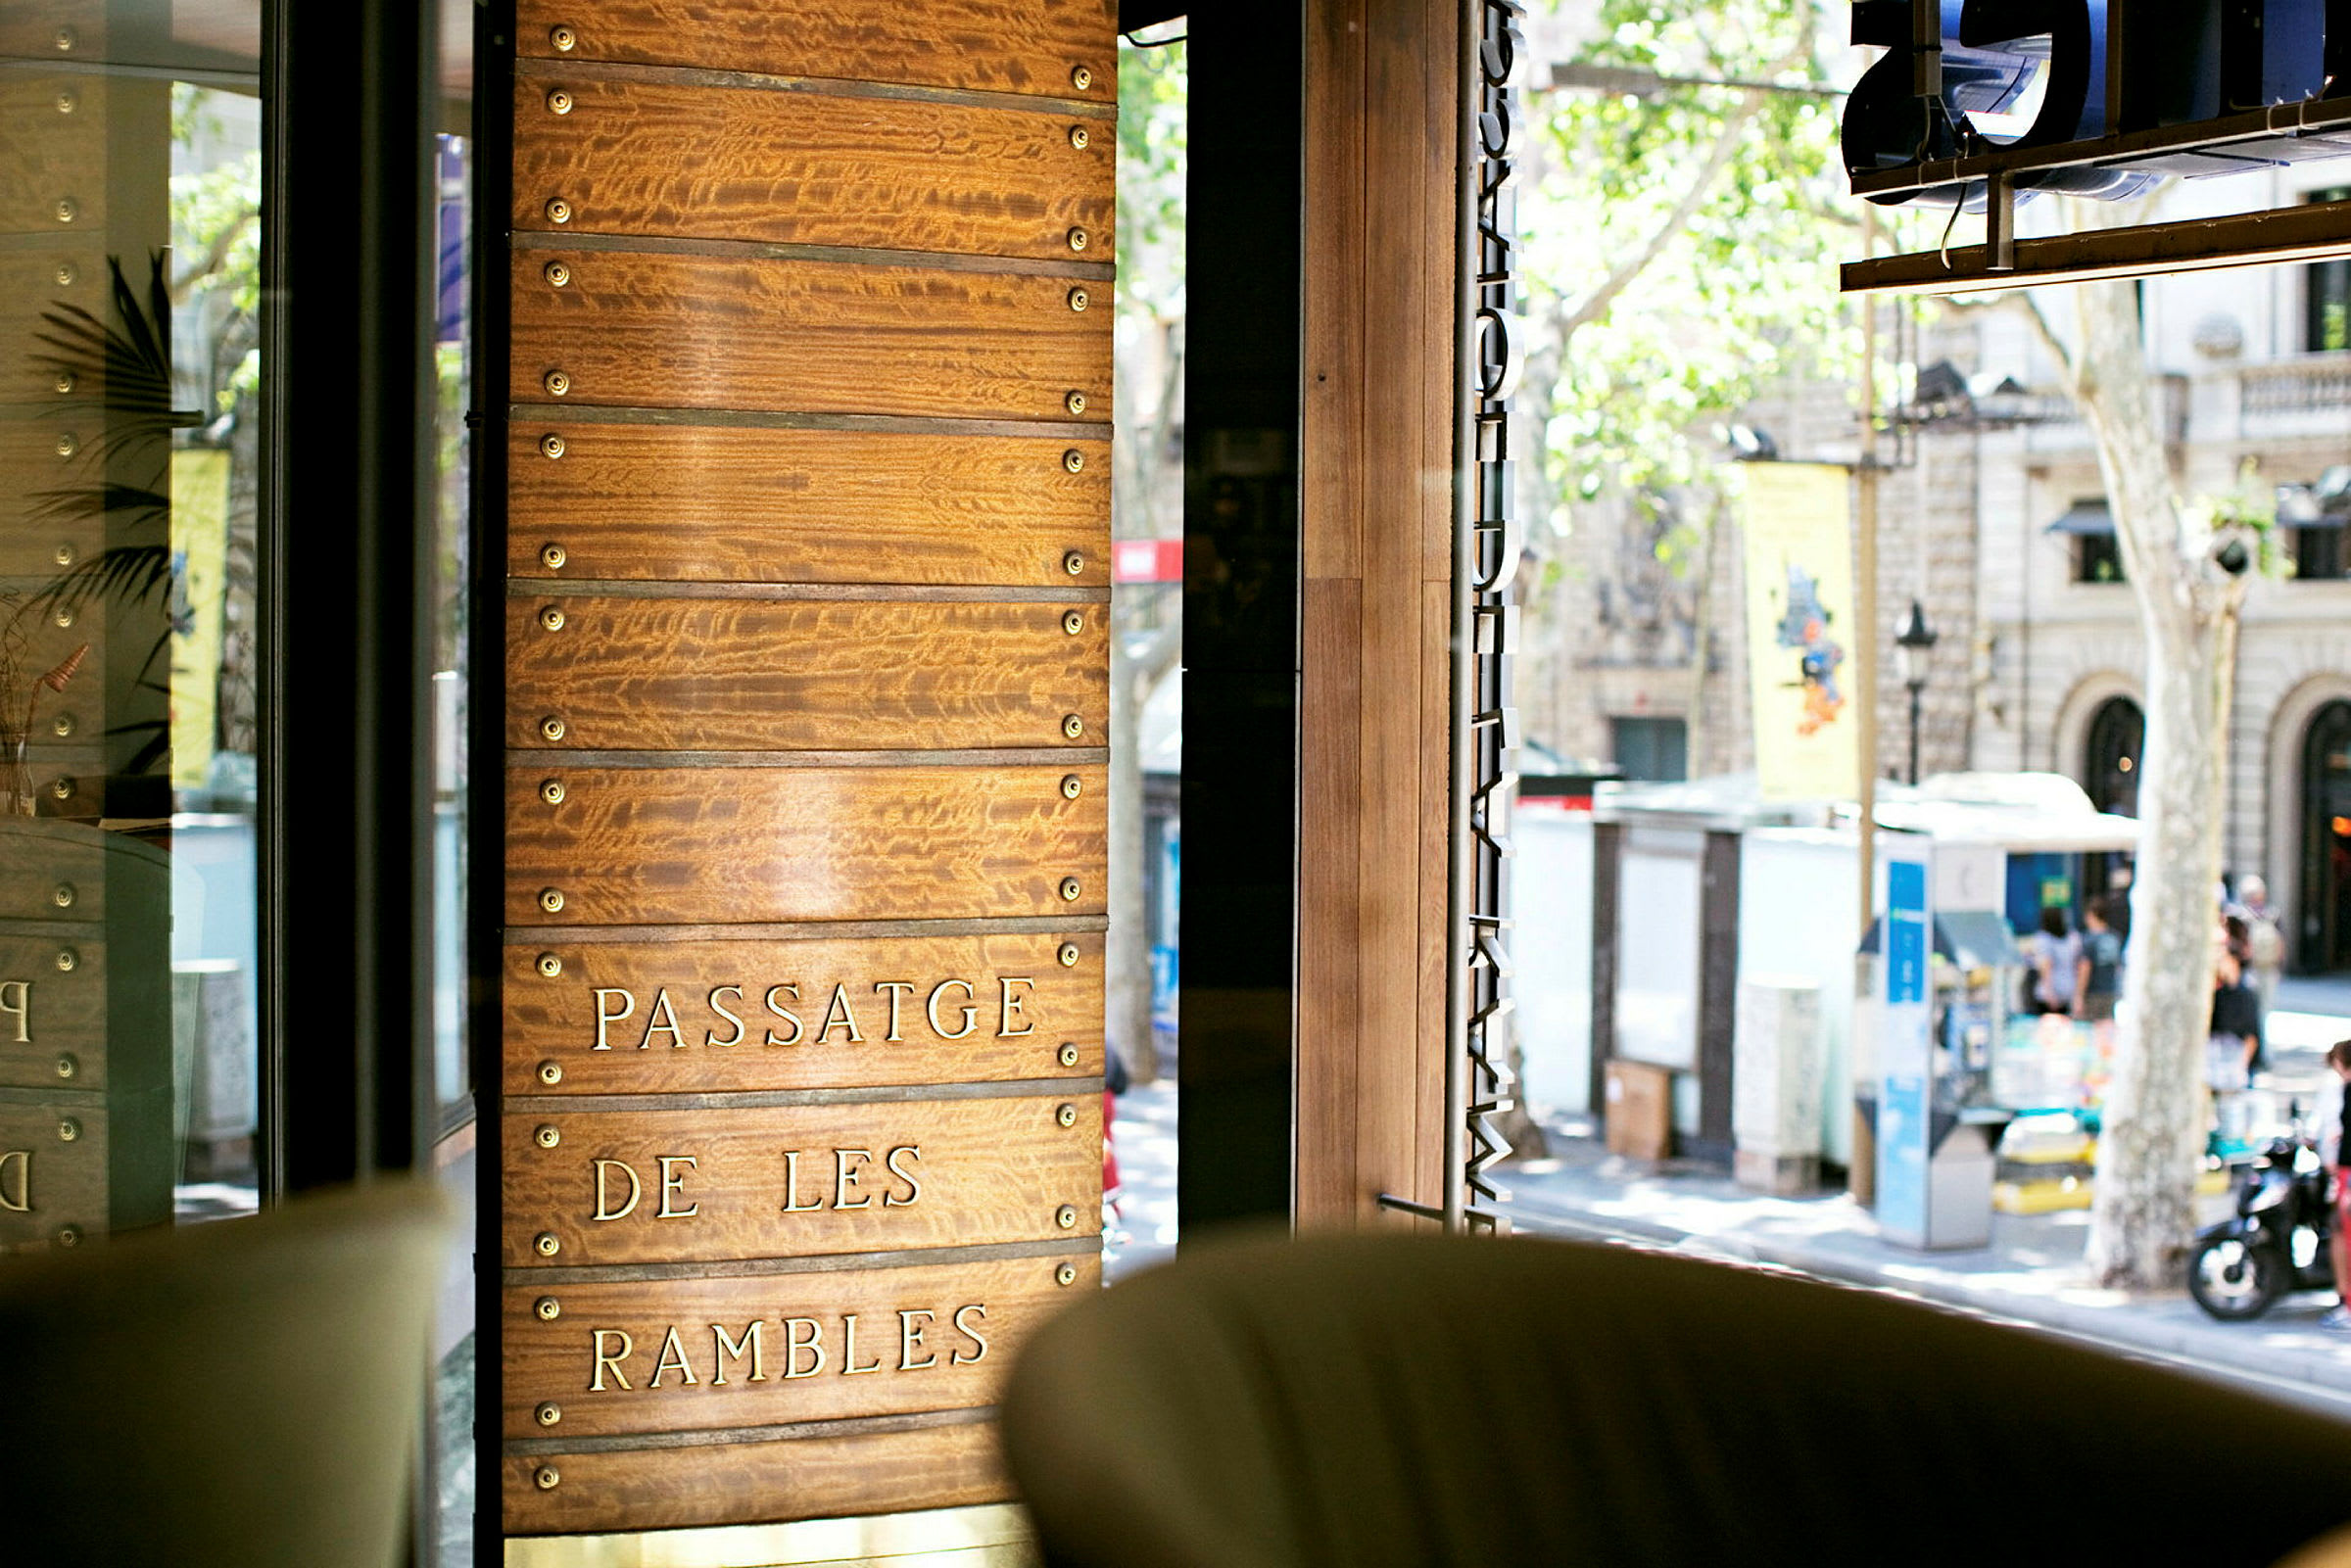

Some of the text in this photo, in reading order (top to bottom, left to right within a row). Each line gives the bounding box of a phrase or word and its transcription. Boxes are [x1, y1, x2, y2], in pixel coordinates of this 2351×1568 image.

[593, 977, 1035, 1051] PASSATGE
[592, 1145, 922, 1221] DE LES
[590, 1304, 989, 1392] RAMBLES
